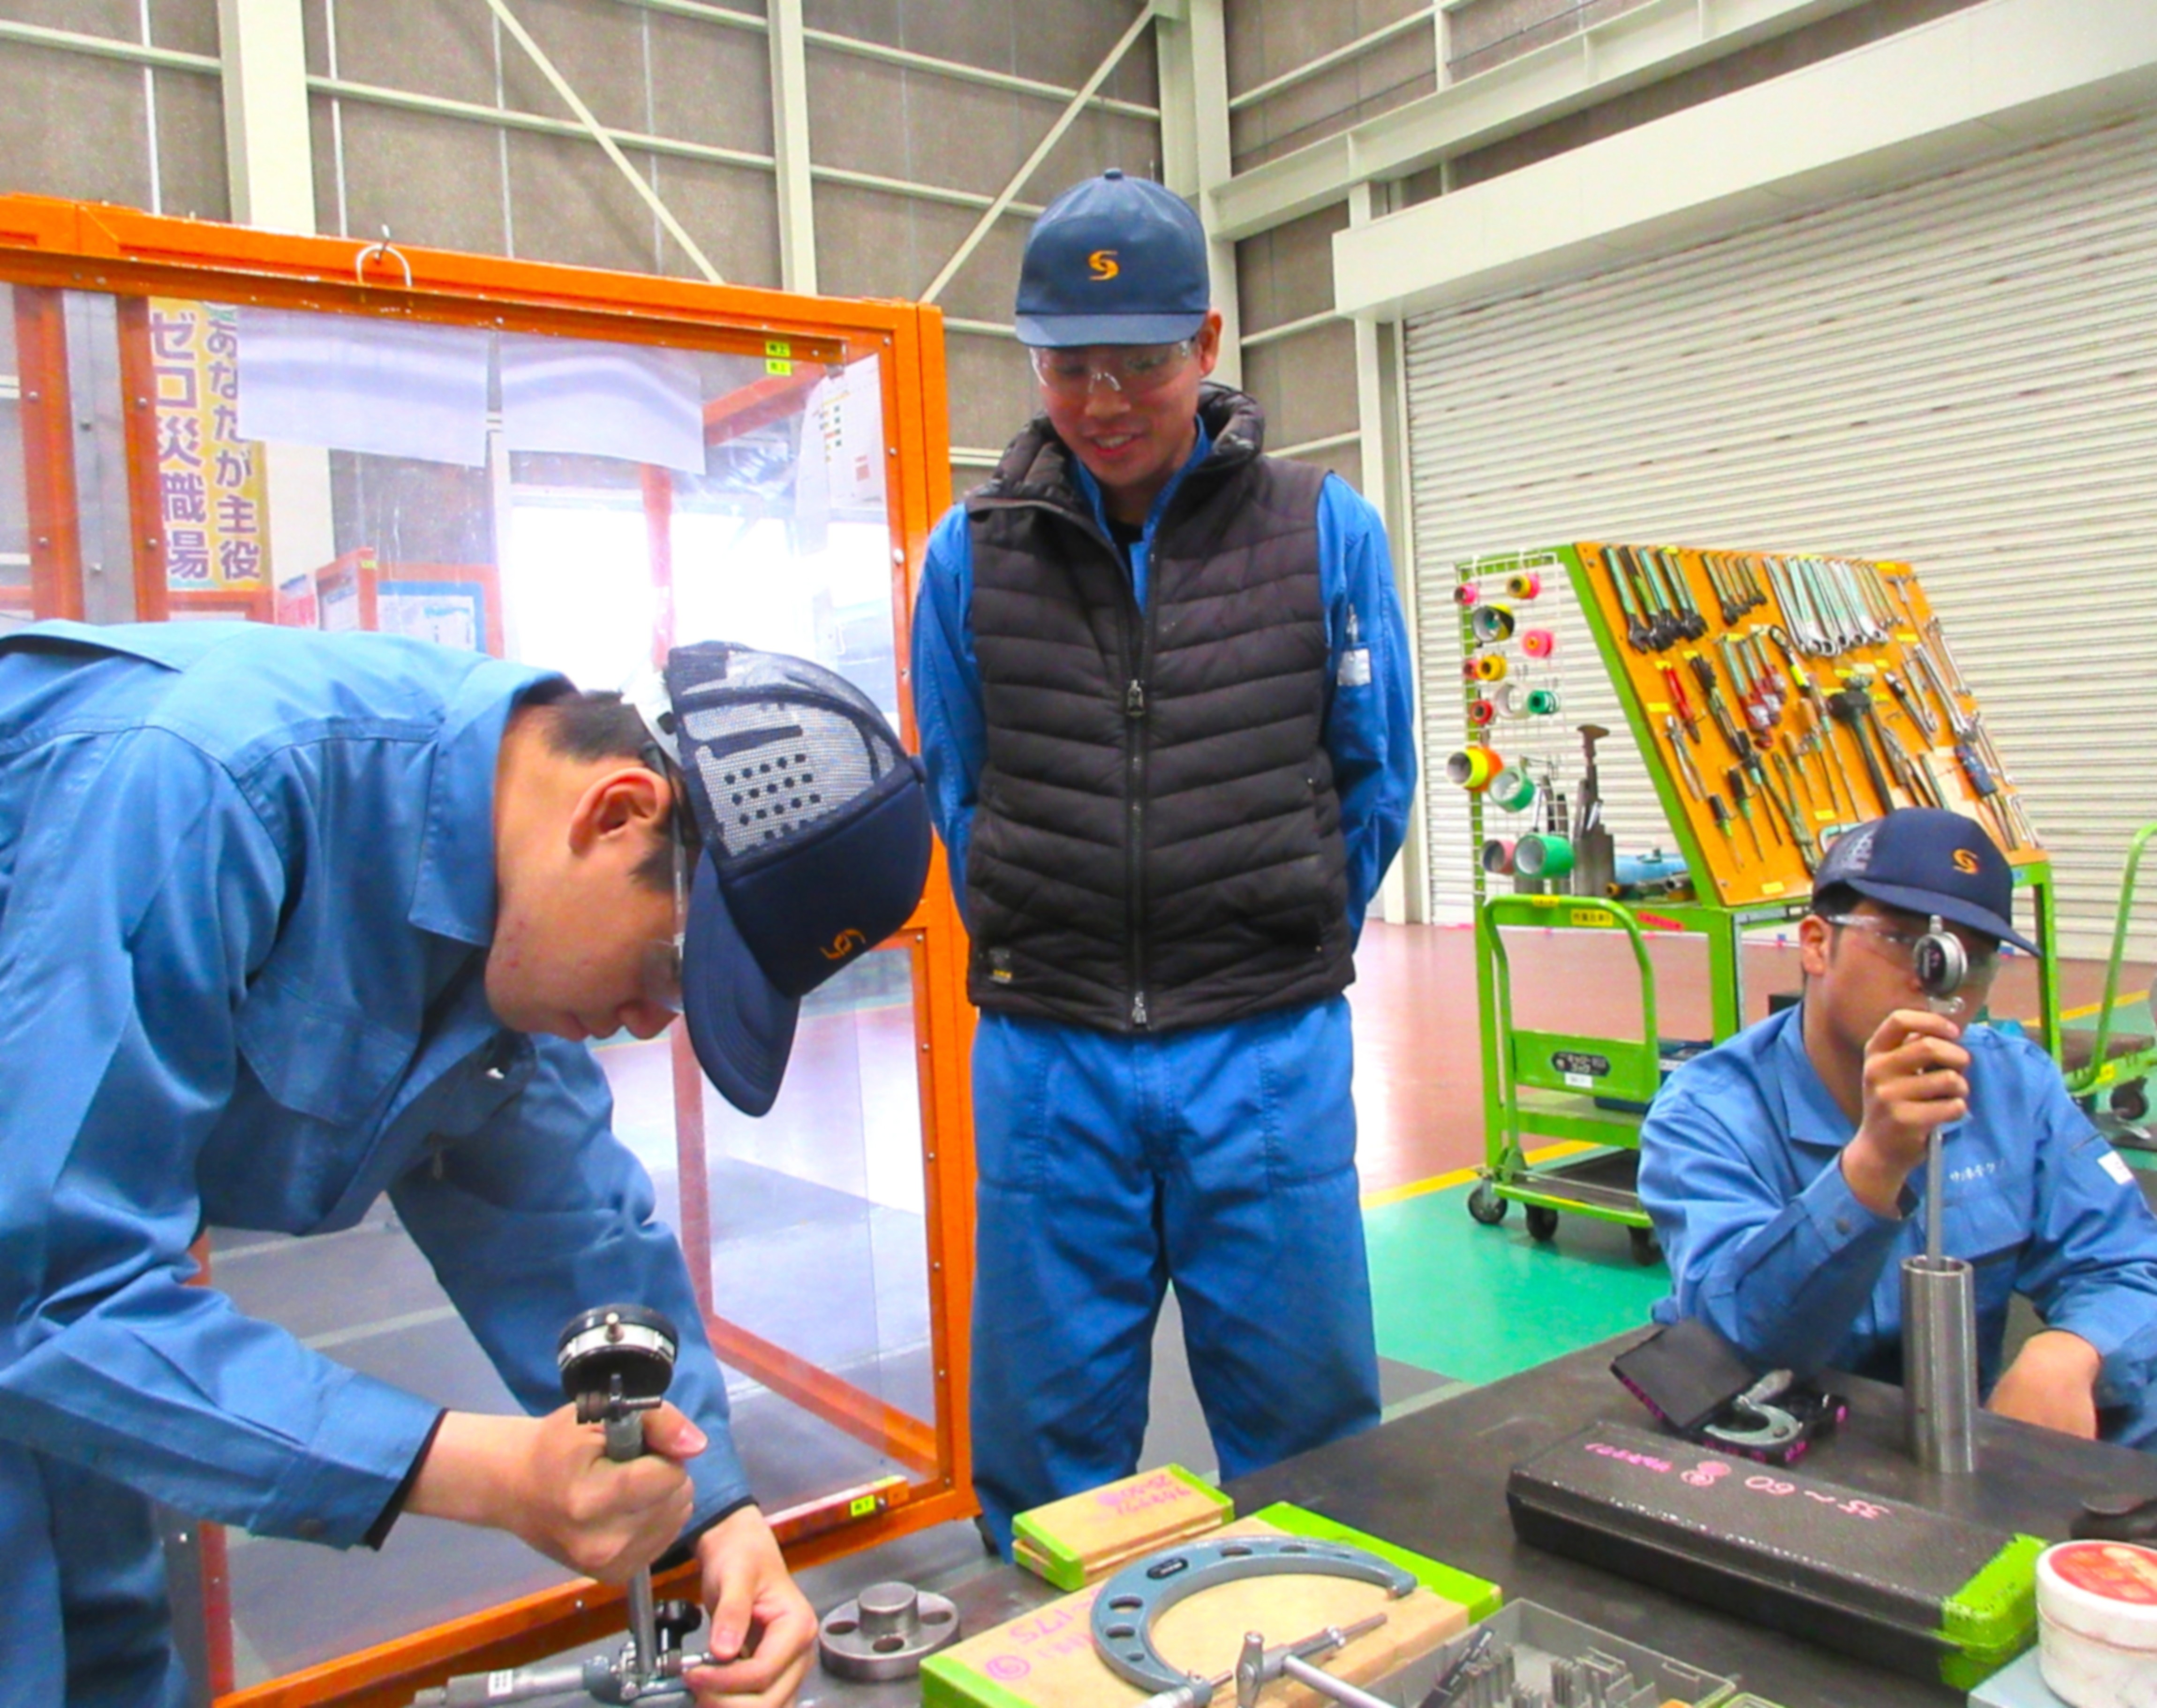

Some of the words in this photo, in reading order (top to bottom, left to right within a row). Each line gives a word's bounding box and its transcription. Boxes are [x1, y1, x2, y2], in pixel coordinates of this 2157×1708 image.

[206, 319, 262, 581] あなたが主役
